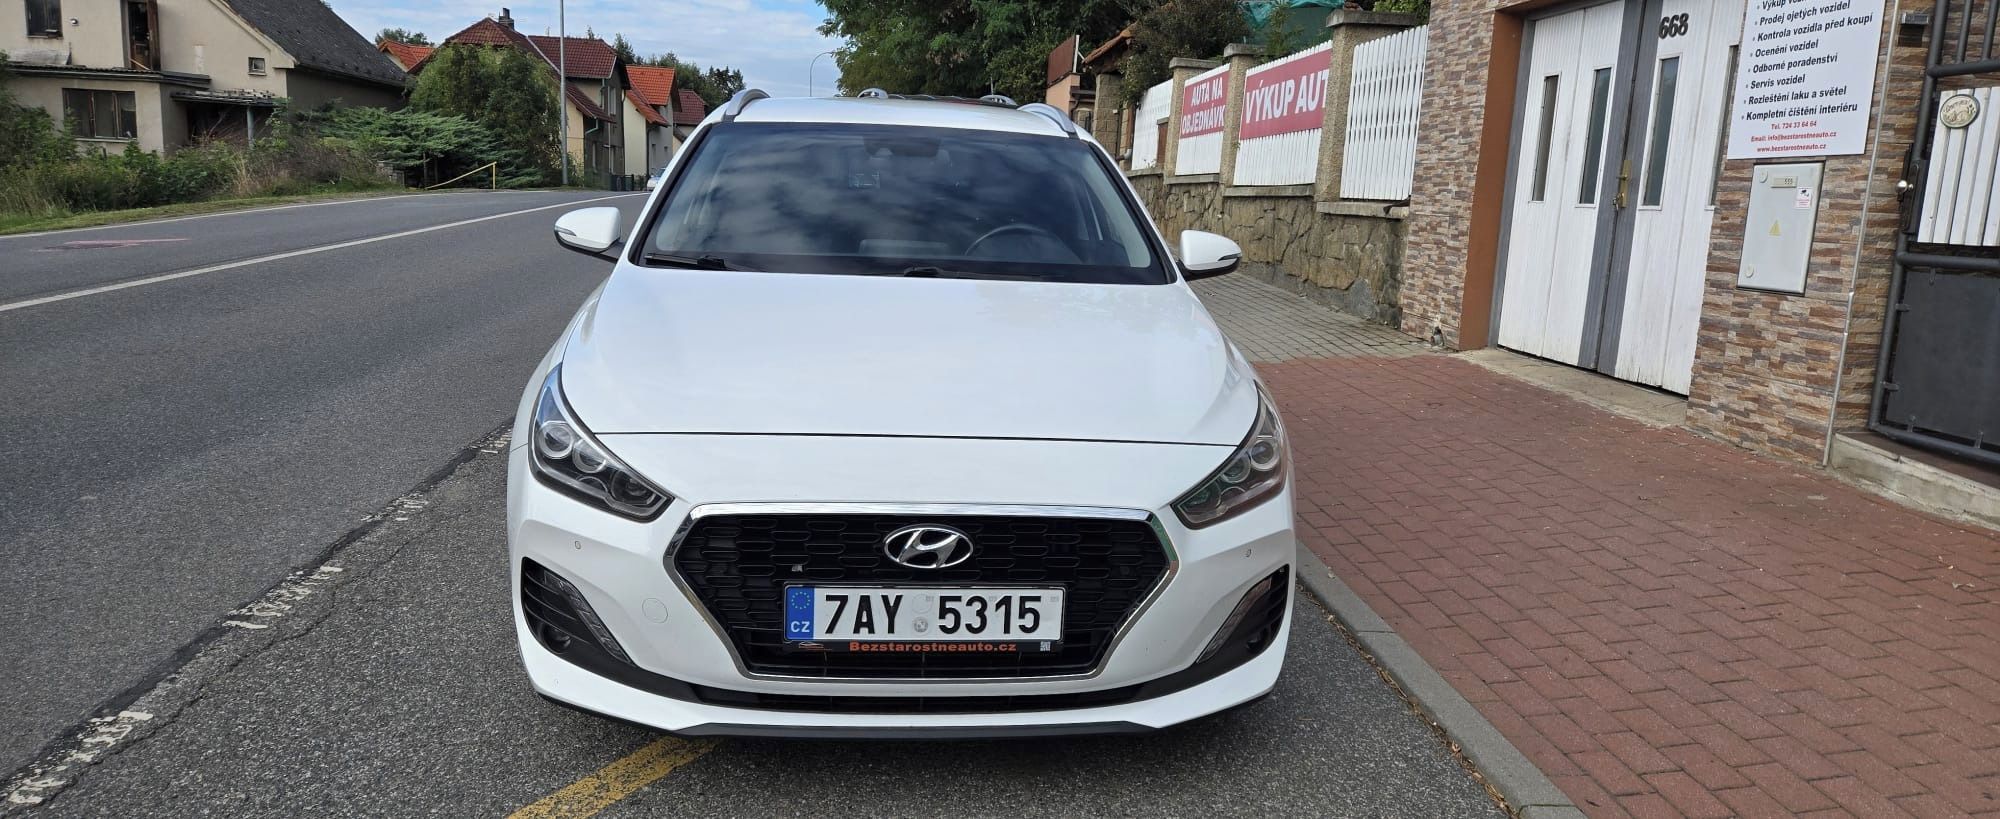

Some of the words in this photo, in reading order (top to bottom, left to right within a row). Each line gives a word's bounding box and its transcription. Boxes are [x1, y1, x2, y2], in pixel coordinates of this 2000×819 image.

[1760, 13, 1785, 25] Prodej
[1787, 7, 1817, 22] ojetých
[1820, 0, 1851, 14] vozidel
[1658, 12, 1690, 39] 668
[1757, 29, 1791, 42] Kontrola
[1793, 22, 1822, 35] vozidla
[1825, 16, 1844, 32] před
[1847, 12, 1873, 26] koupí
[1755, 44, 1787, 57] Ocenění
[1790, 39, 1819, 52] vozidel
[1753, 61, 1785, 73] Odborné
[1787, 52, 1838, 70] poradenství
[1191, 81, 1210, 107] AUTA
[1211, 76, 1223, 101] NA
[1750, 79, 1774, 90] Servis
[1777, 73, 1806, 86] vozidel
[1246, 79, 1295, 124] VÝKUP
[1748, 92, 1789, 105] Rozleštění
[1791, 89, 1810, 101] laku
[1811, 91, 1817, 99] a
[1819, 85, 1847, 98] světel
[1746, 107, 1787, 121] Kompletní
[1819, 102, 1858, 115] interiéru
[824, 594, 903, 635] 7AY
[938, 595, 1043, 635] 5315
[790, 621, 810, 632] CZ
[849, 641, 1017, 652] Bezstarostneauto.cz
